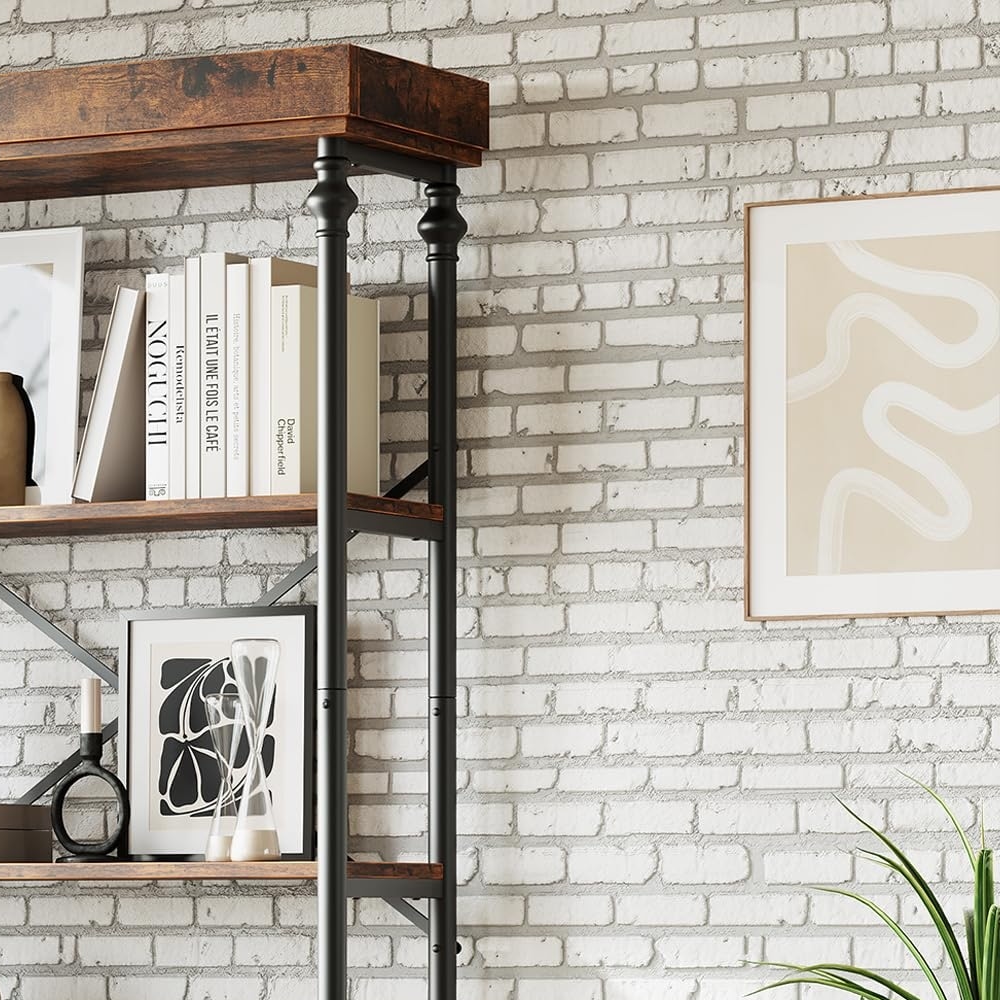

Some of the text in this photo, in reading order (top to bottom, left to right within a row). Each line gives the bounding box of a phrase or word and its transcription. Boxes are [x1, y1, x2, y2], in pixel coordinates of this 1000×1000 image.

[148, 320, 167, 447] NOGUCHI
[175, 344, 186, 424] Remodelista
[205, 314, 221, 452] IL ÉTAIT UNE FOIS LE CAFÉ
[275, 418, 286, 475] Chipperfield
[286, 418, 296, 444] David
